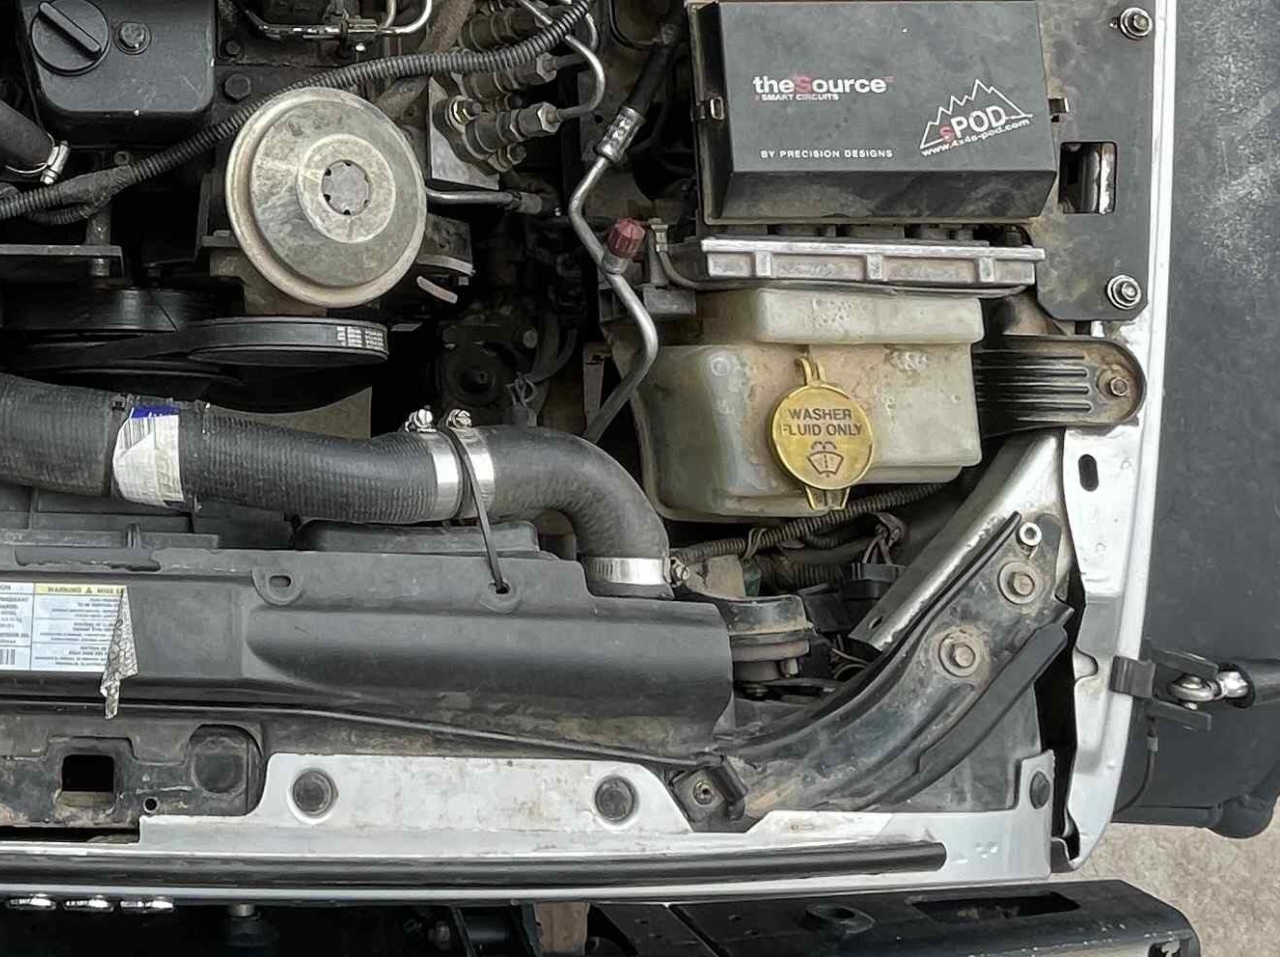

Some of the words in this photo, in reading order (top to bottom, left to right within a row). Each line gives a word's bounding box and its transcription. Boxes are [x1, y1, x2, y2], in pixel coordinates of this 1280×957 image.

[753, 76, 887, 93] theSource
[761, 93, 793, 101] SMART
[796, 93, 839, 101] CIRCUITS
[761, 150, 776, 158] BY
[780, 150, 840, 158] PRECISION
[844, 150, 893, 158] DESIGNS
[788, 408, 853, 421] WASHER
[826, 424, 862, 436] ONLY
